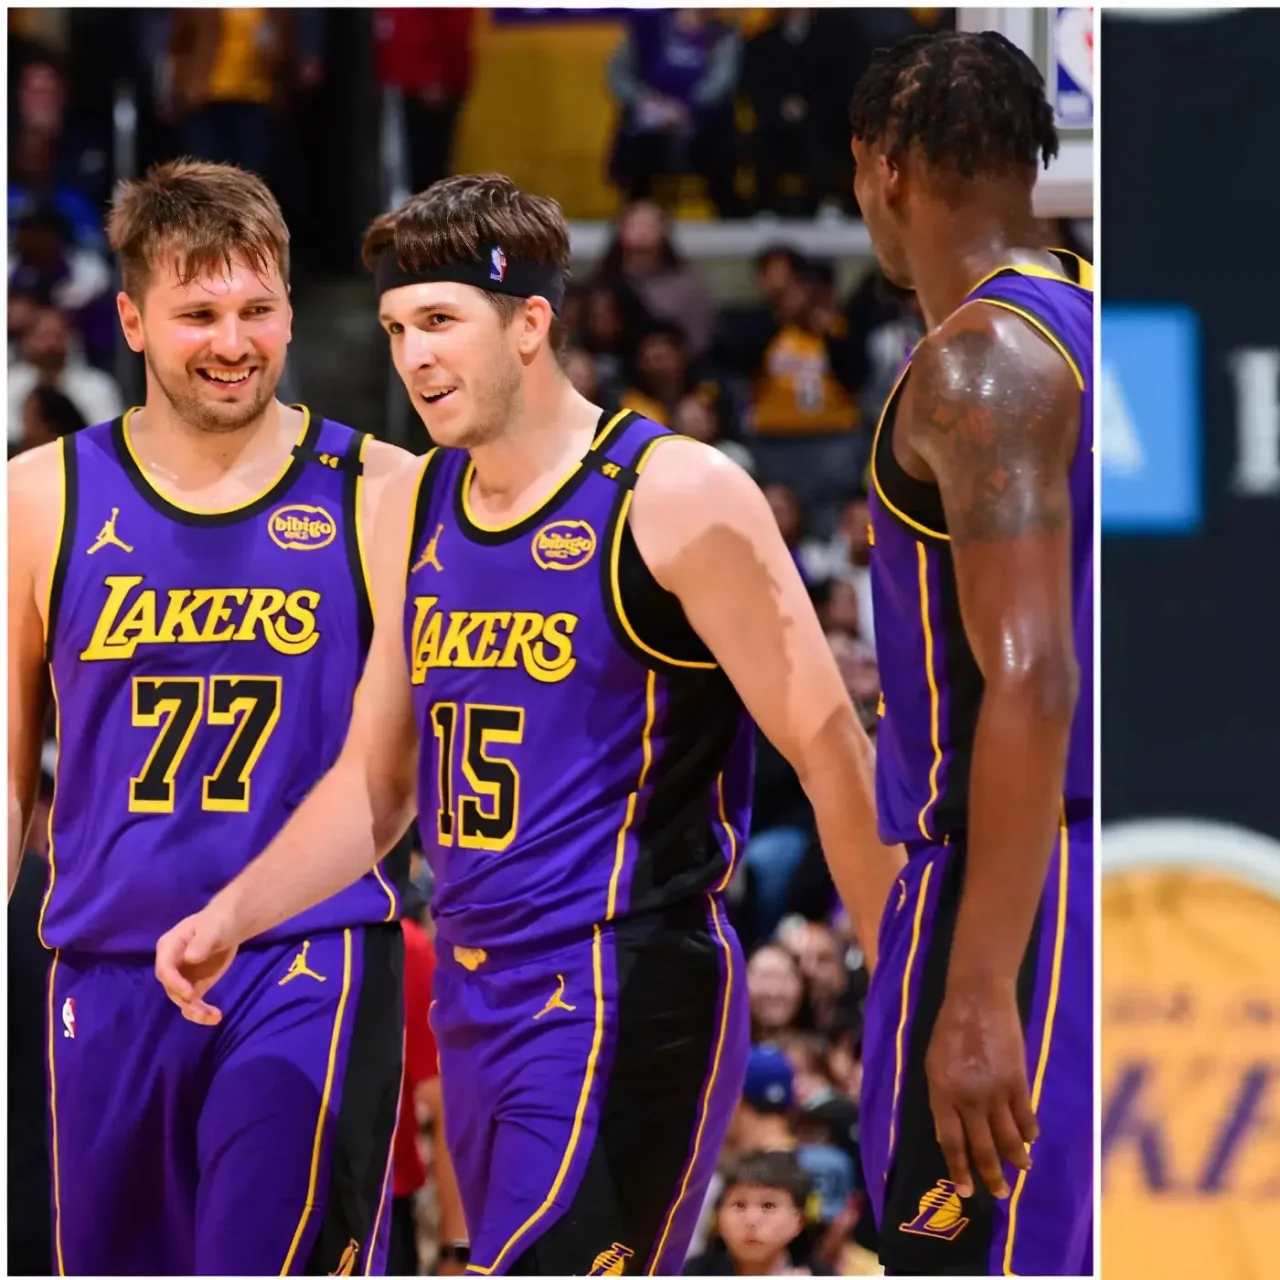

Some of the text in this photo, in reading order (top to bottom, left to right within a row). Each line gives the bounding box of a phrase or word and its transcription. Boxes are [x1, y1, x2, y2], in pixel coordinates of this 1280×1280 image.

[275, 516, 331, 538] bibigo
[80, 575, 320, 661] LAKERS
[411, 596, 578, 684] LAKERS
[128, 674, 282, 813] 77
[430, 702, 525, 851] 15
